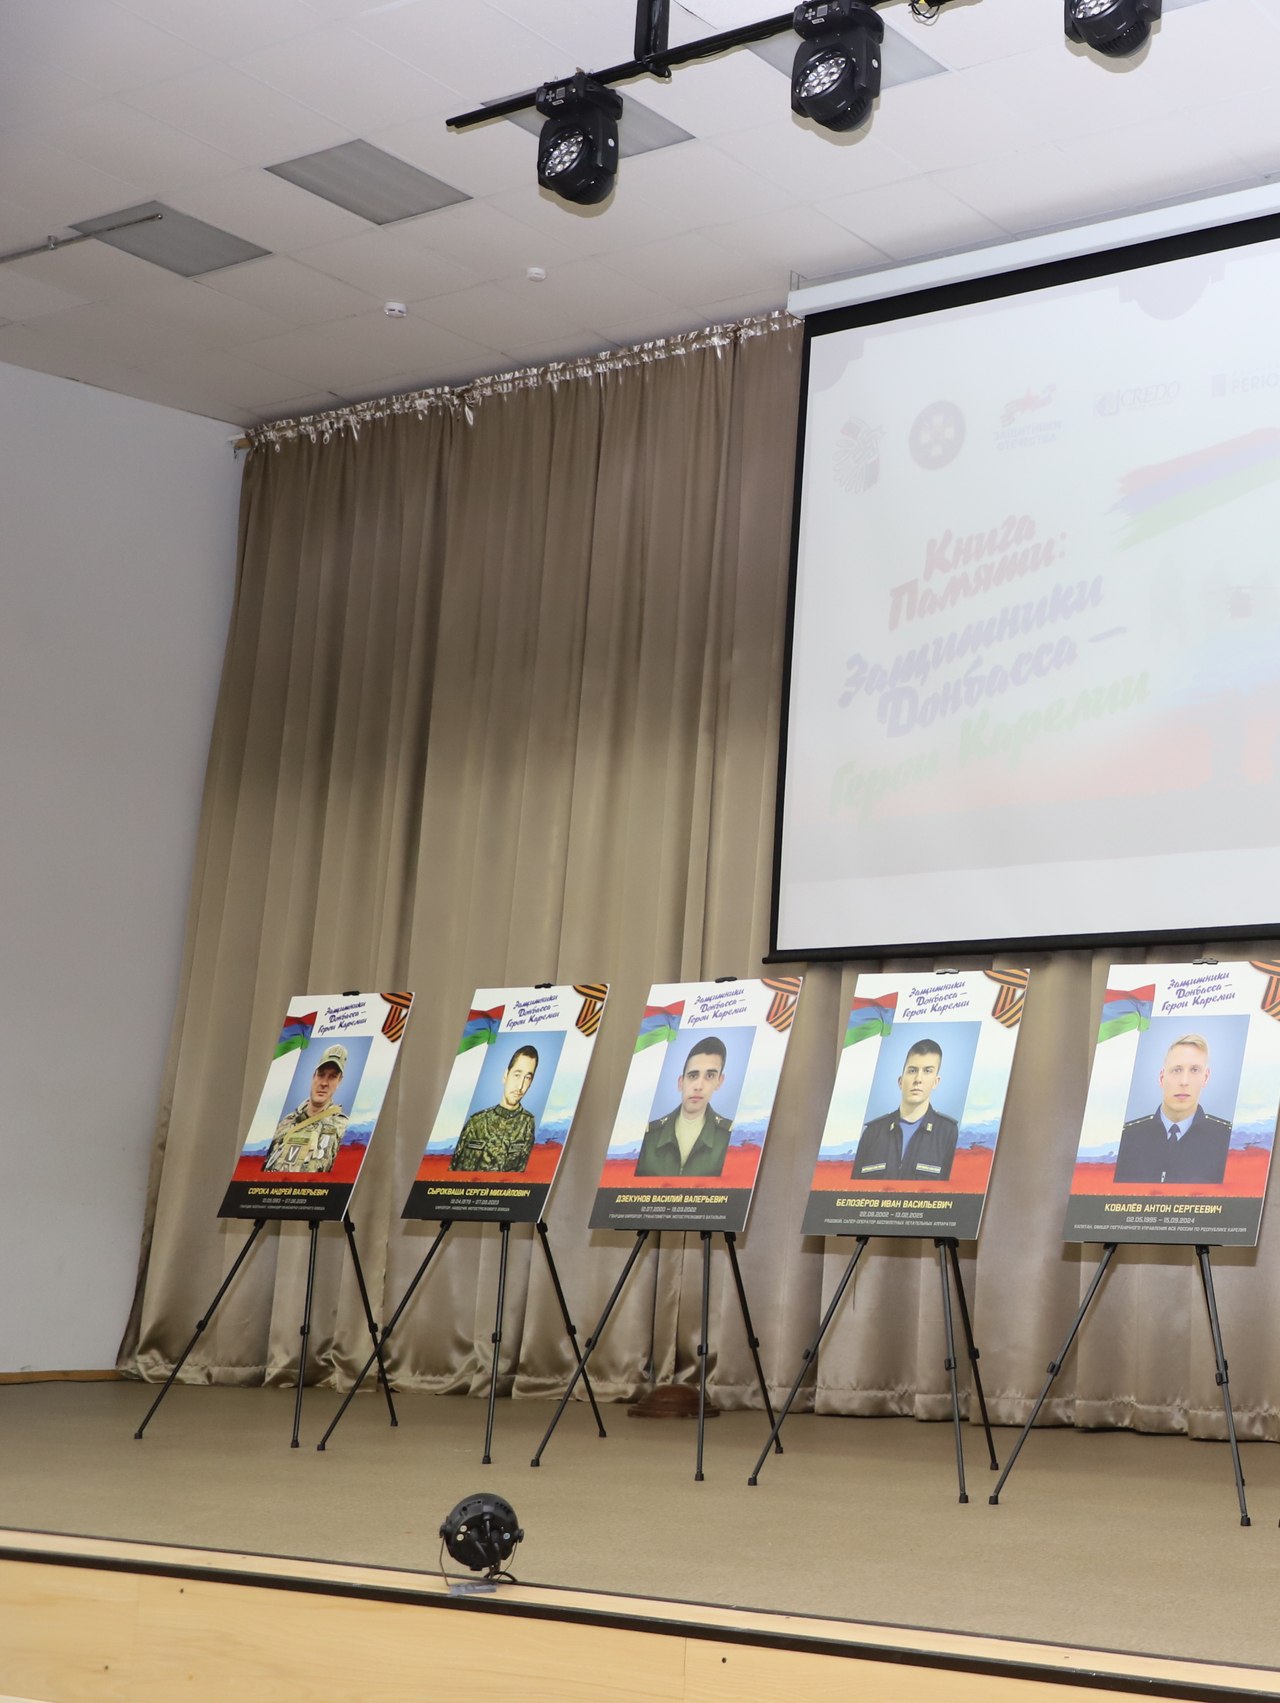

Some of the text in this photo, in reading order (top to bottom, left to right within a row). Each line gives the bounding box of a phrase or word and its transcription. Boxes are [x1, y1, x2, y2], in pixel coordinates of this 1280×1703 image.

[923, 515, 1036, 581] Книга
[889, 532, 1067, 631] Памяти:
[838, 575, 1105, 708] Защитники
[876, 635, 1078, 738] Донбасса
[958, 671, 1151, 773] Карелии
[1168, 972, 1229, 990] Защитники
[1176, 984, 1222, 999] Донбасса
[1162, 991, 1235, 1015] Герои Карелии
[427, 1187, 531, 1197] СЫРОКВАША СЕРГЕЙ МИХАЙЛОВИЧ
[616, 1194, 728, 1204] ДЗЕКУНОВ ВАСИЛИЙ ВАЛЕРЬЕВИЧ
[836, 1198, 953, 1209] БЕЛОЗЁРОВ ИВАН ВАСИЛЬЕВИЧ
[1104, 1203, 1222, 1214] КОВАЛЁВ АНТОН СЕРГЕЕВИЧ
